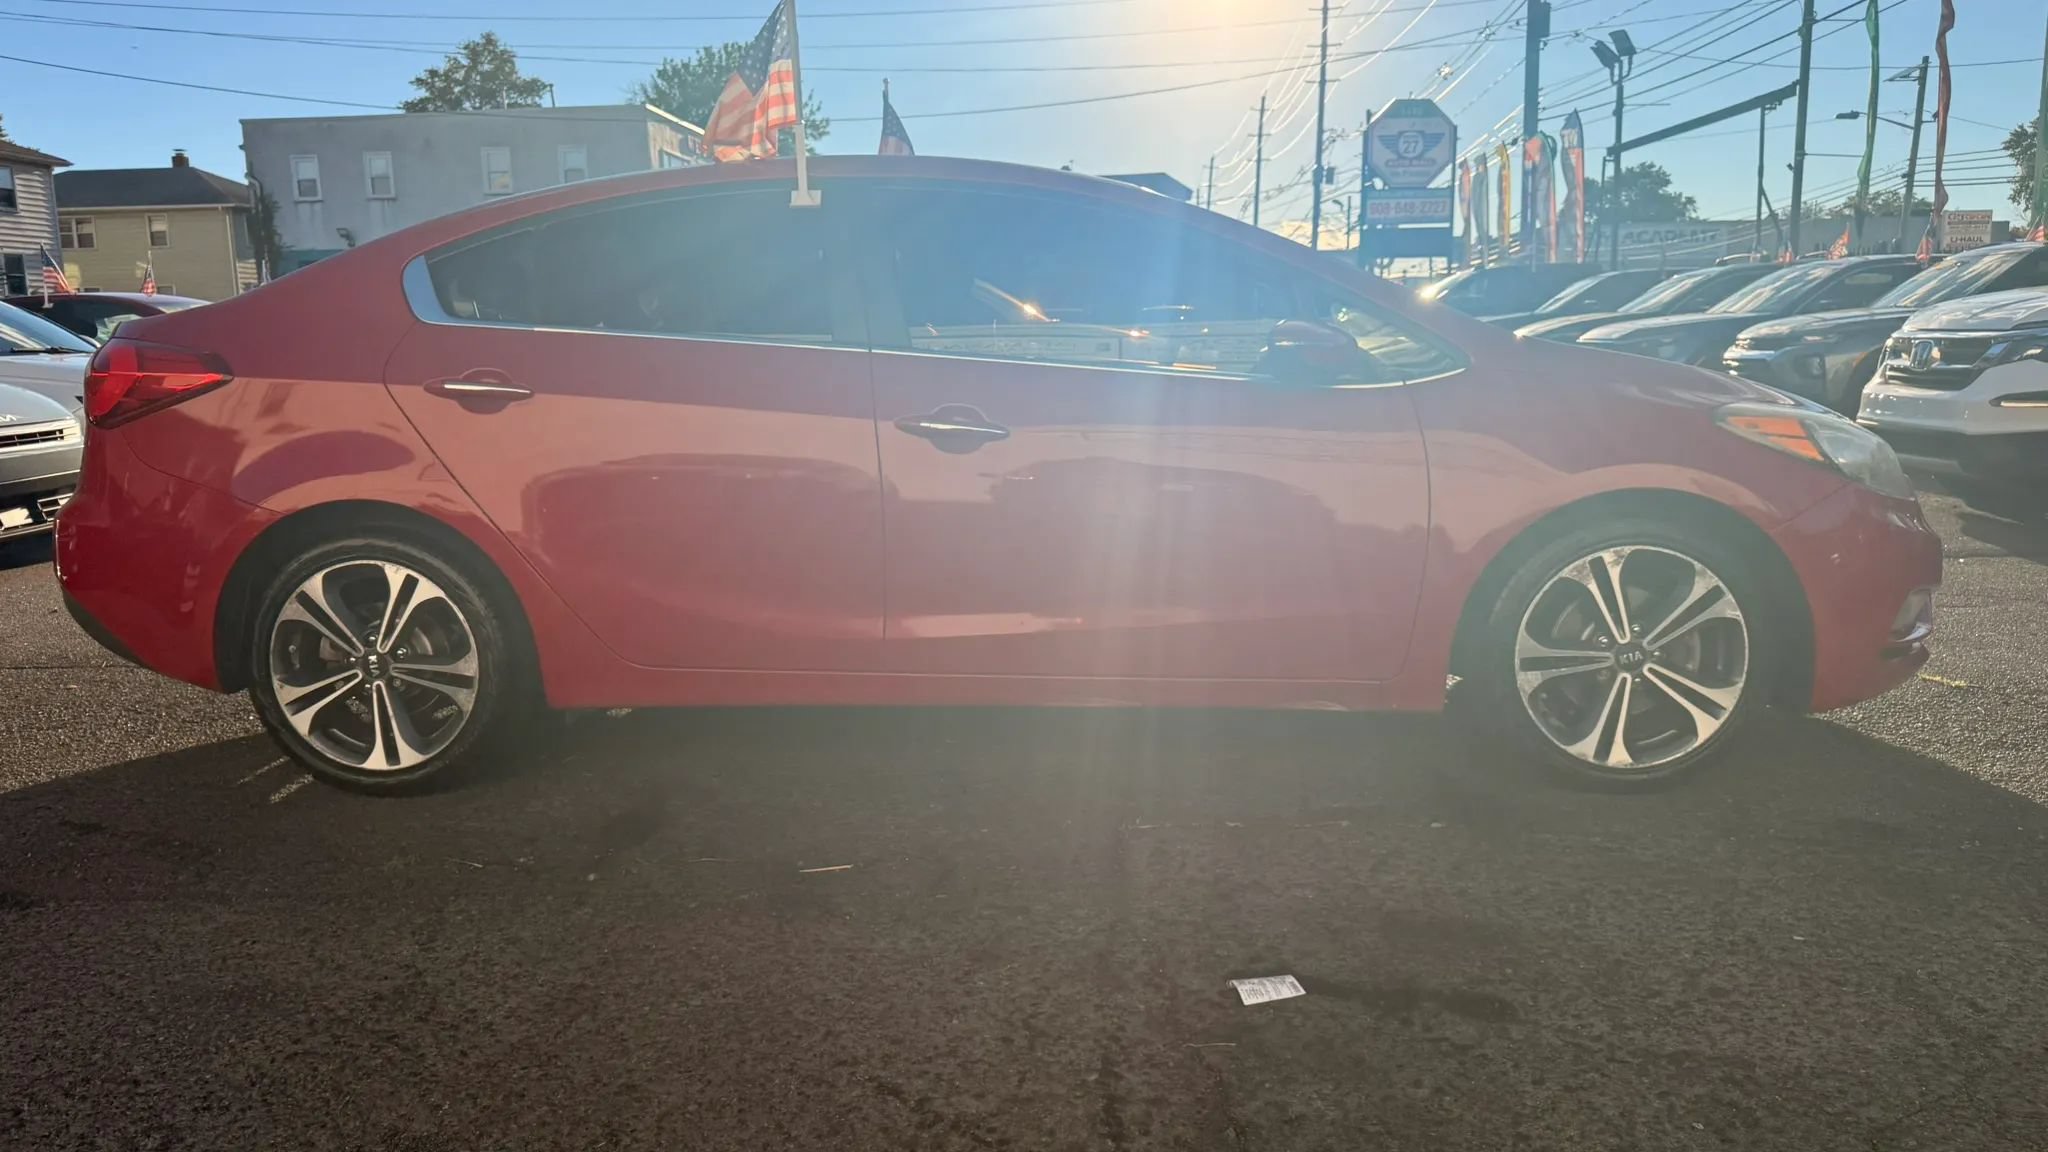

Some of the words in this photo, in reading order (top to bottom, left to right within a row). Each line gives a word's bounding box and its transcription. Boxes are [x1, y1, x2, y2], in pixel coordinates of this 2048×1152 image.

[1403, 140, 1418, 154] 27
[1950, 235, 1984, 243] U-HAUL
[1618, 650, 1644, 665] KIA
[367, 654, 380, 678] KIA
